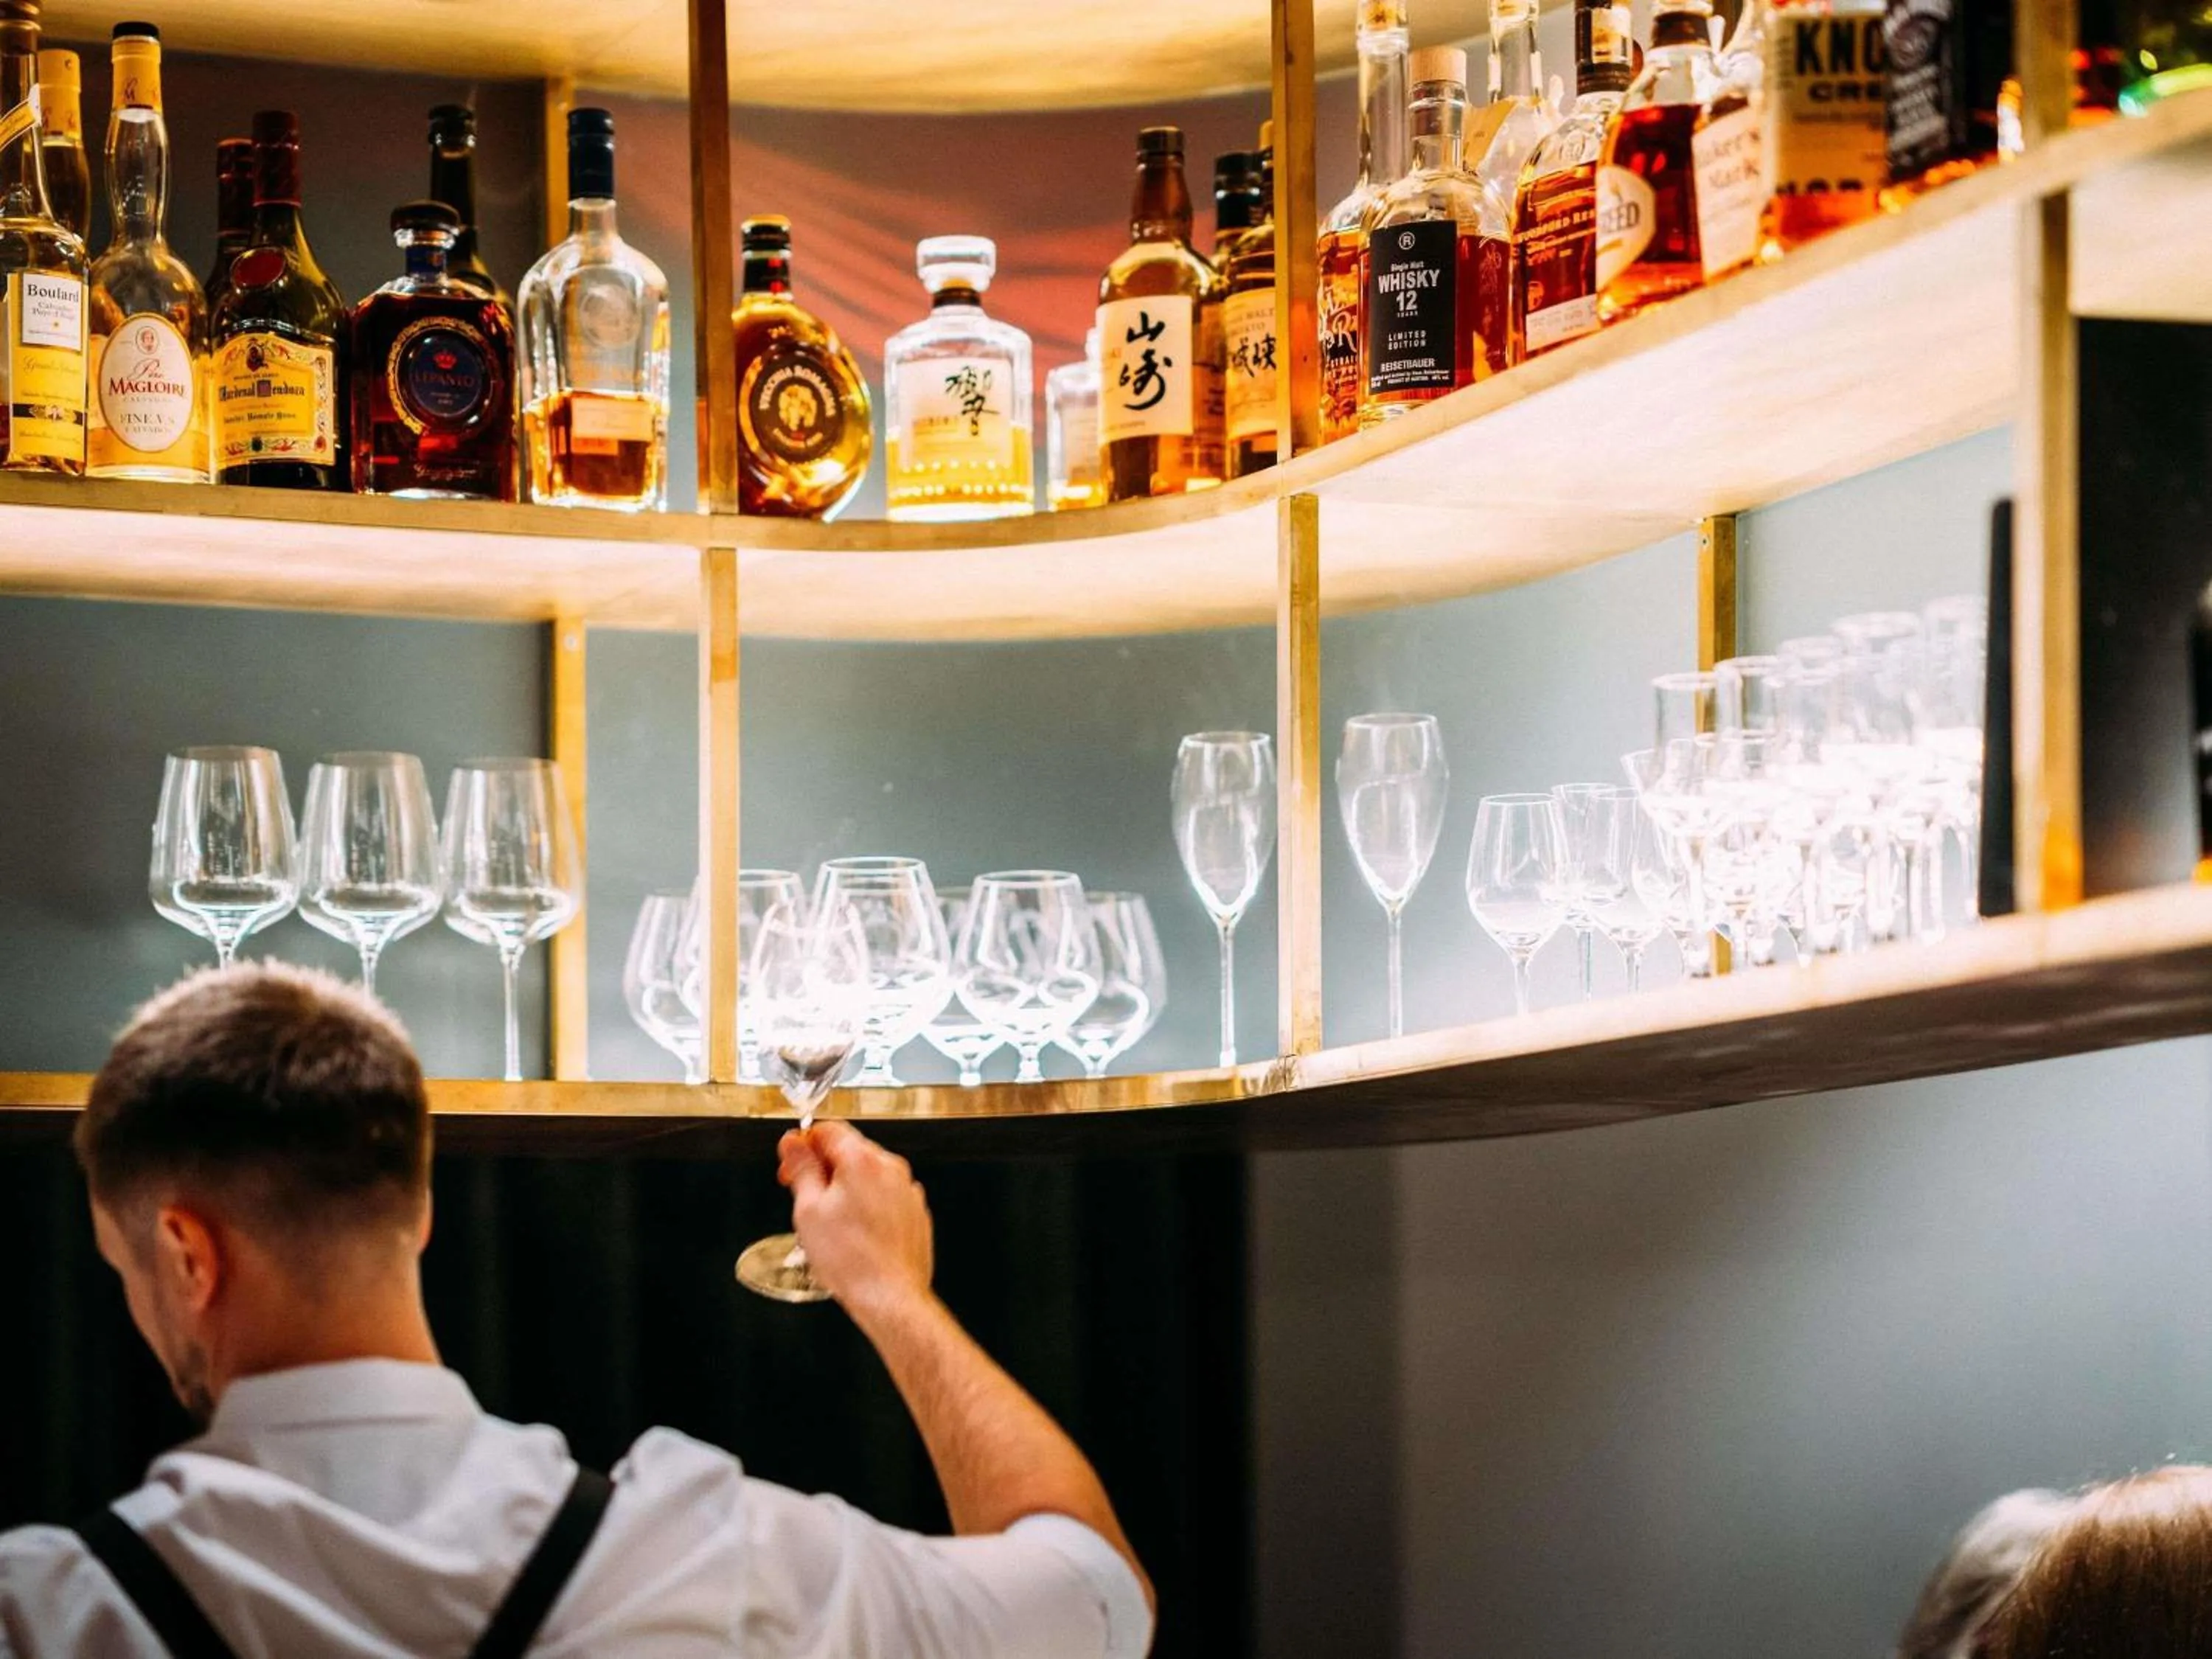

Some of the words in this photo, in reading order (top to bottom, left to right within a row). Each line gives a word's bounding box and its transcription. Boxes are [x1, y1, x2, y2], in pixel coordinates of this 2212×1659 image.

[1378, 268, 1440, 294] WHISKY
[27, 283, 80, 303] Boulard
[1396, 290, 1418, 311] 12
[1388, 330, 1427, 341] LIMITED
[1388, 339, 1427, 350] EDITION
